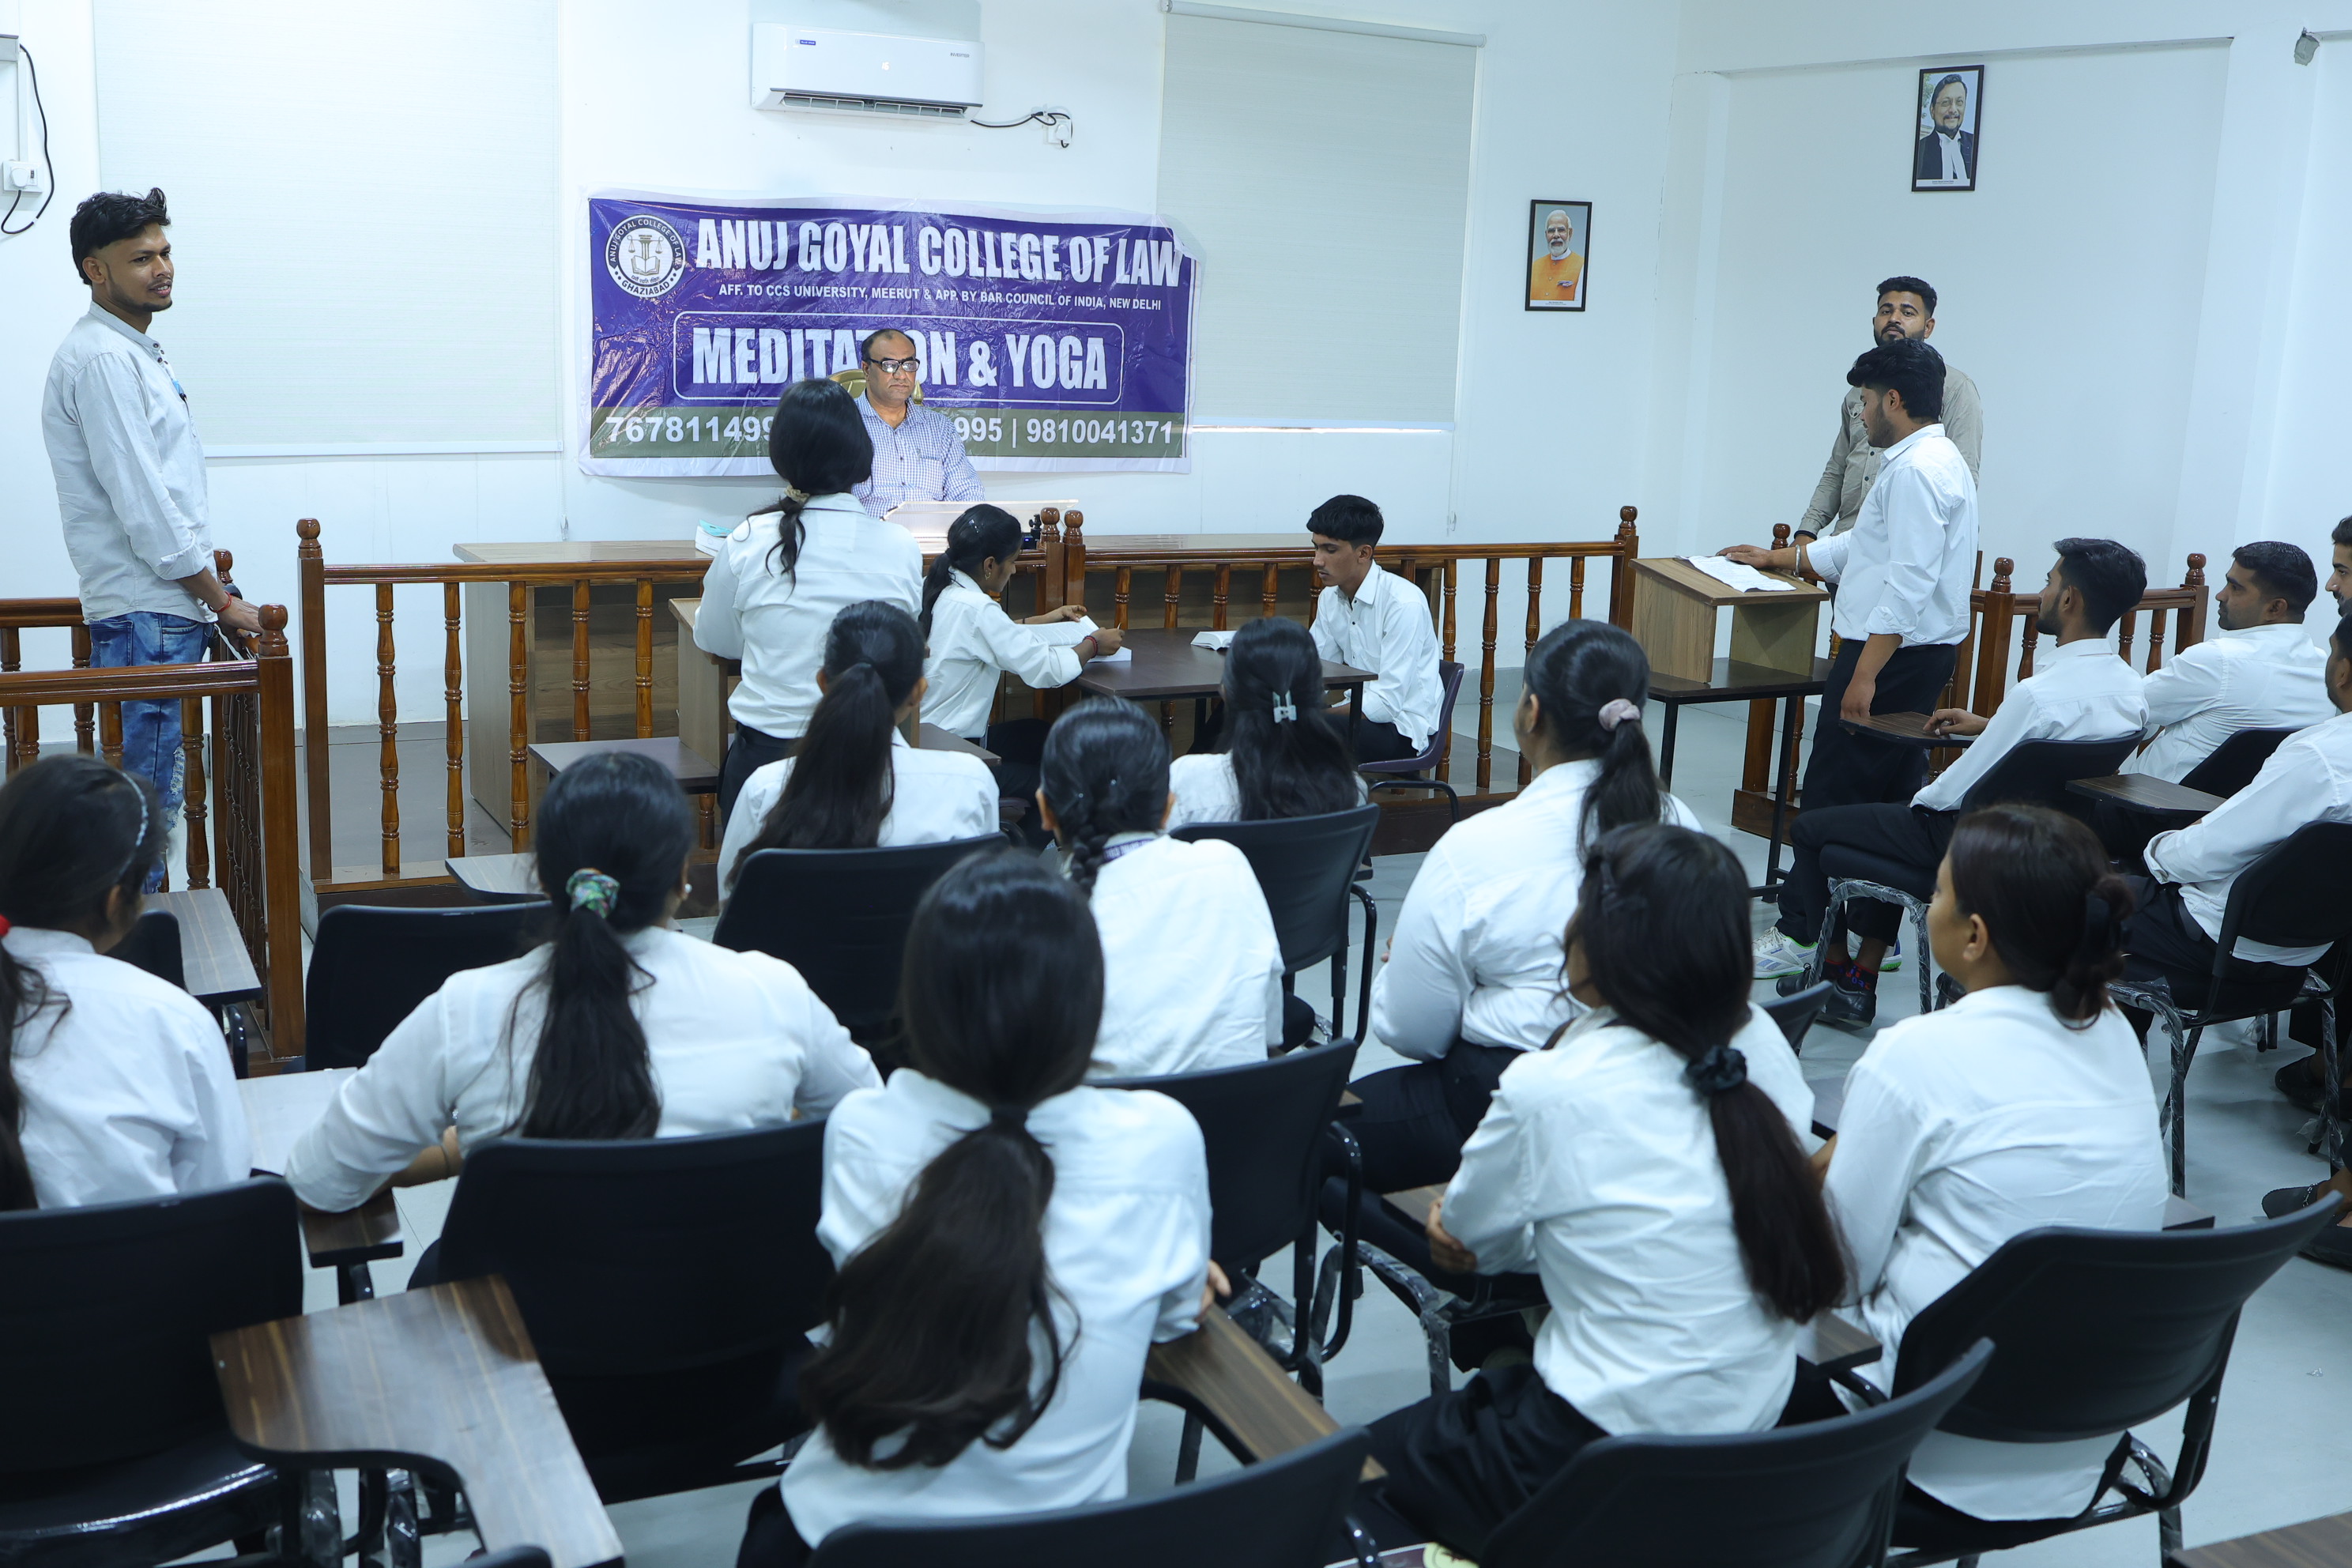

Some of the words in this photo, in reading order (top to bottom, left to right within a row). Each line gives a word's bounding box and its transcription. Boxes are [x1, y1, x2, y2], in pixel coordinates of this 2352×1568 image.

[615, 220, 637, 240] GOYAL
[638, 219, 671, 236] COLLEGE
[669, 236, 679, 245] OF
[695, 218, 789, 270] ANUJ
[797, 221, 910, 273] GOYAL
[918, 226, 1062, 281] COLLEGE
[1069, 236, 1110, 283] OF
[1115, 238, 1184, 287] LAW
[621, 280, 670, 296] GHAZIABAD
[718, 284, 743, 296] AFF.
[746, 285, 763, 296] TO
[766, 285, 790, 296] CCS
[794, 285, 869, 300] UNIVERSITY,
[872, 287, 920, 300] MEERUT
[924, 288, 932, 300] &
[935, 290, 959, 301] APP.
[961, 291, 977, 302] BY
[980, 292, 1003, 303] BAR
[1005, 292, 1055, 306] COUNCIL
[1057, 295, 1072, 306] OF
[1074, 296, 1106, 310] INDIA,
[1110, 297, 1131, 309] NEW
[1133, 298, 1161, 311] DELHI
[692, 327, 958, 386] MEDITAON
[967, 340, 998, 387] &
[1004, 334, 1107, 390] YOGA
[1027, 418, 1172, 444] 9810041371
